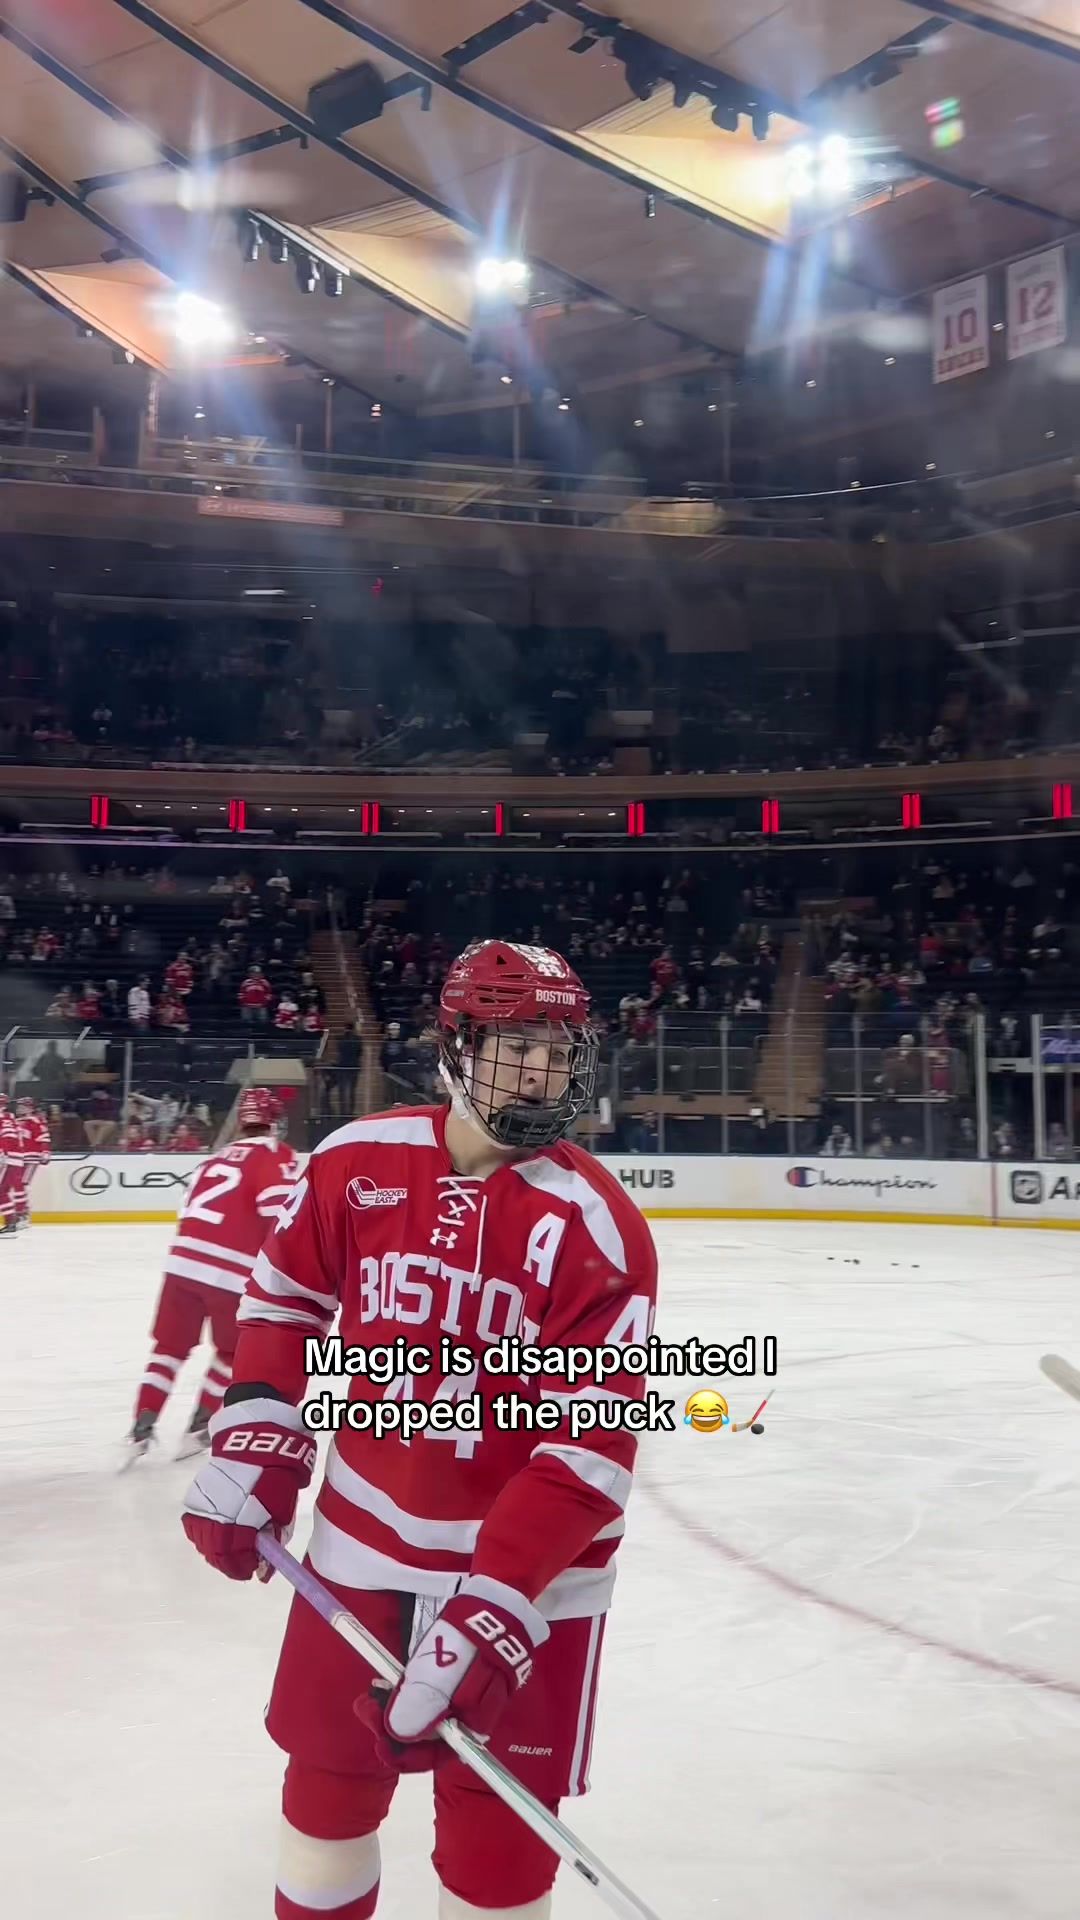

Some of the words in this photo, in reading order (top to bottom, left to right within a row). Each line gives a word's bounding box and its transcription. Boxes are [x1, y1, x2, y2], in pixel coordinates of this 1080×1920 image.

[1019, 281, 1056, 325] 12
[944, 307, 977, 351] 10
[535, 989, 576, 1006] BOSTON
[376, 1189, 407, 1197] HOCKEY
[619, 1169, 674, 1189] HUB
[786, 1166, 938, 1197] Champion
[523, 1211, 566, 1288] A
